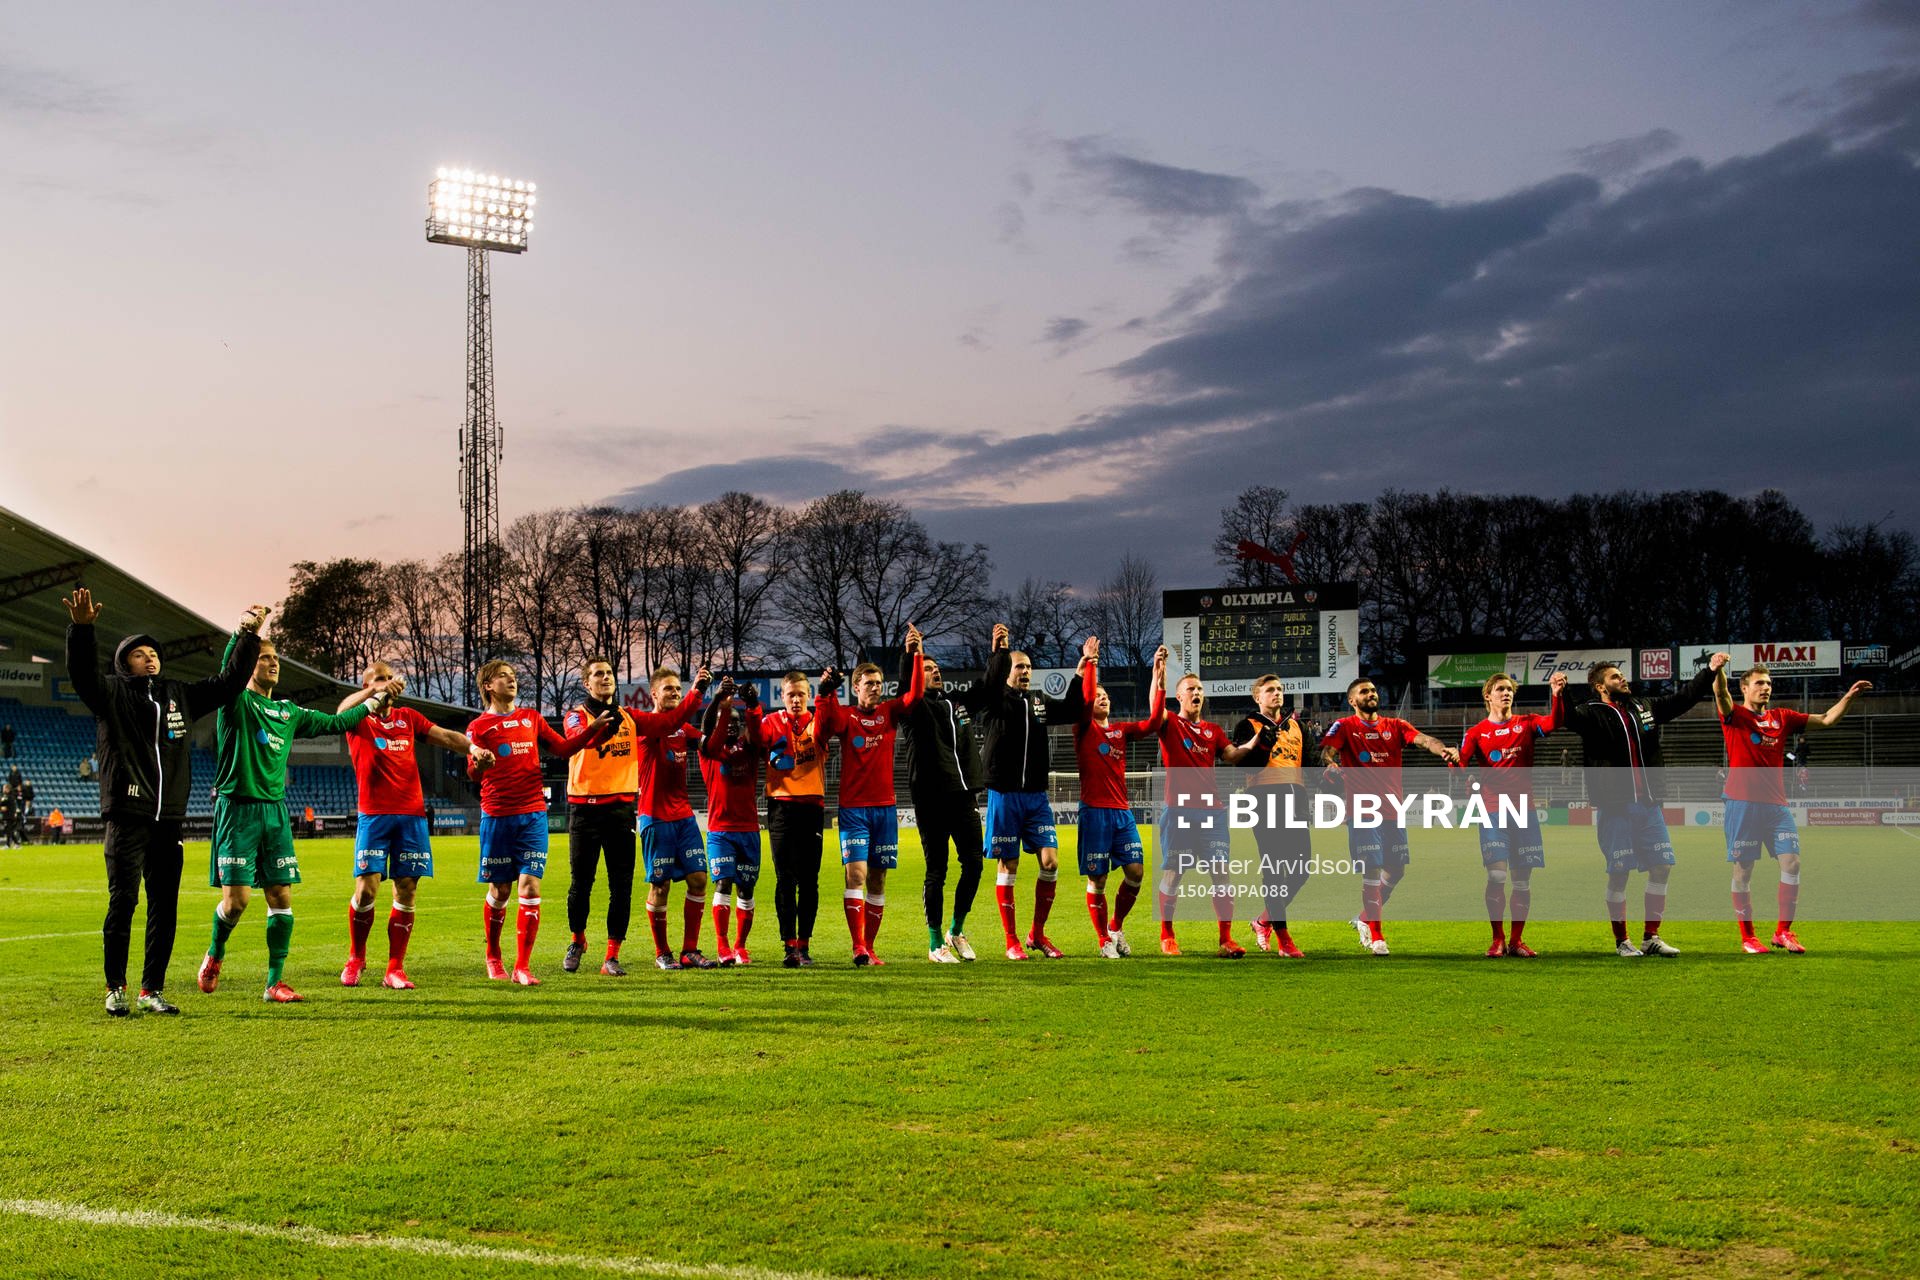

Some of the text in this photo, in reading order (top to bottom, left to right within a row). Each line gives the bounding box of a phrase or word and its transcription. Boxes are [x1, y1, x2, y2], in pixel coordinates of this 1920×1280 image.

[1222, 592, 1295, 606] OLYMPIA
[1214, 616, 1231, 626] 2-0
[1209, 629, 1238, 639] 94:02
[1184, 622, 1192, 675] ORRPORTEN
[1328, 615, 1337, 679] NORRPORTEN
[1753, 644, 1817, 662] MAXI
[1643, 651, 1668, 664] nya
[1212, 683, 1247, 693] Lokaler
[1298, 680, 1310, 690] till
[610, 741, 631, 751] INTER
[127, 784, 140, 797] HL
[222, 857, 247, 865] SOLID
[488, 857, 512, 865] SOLID
